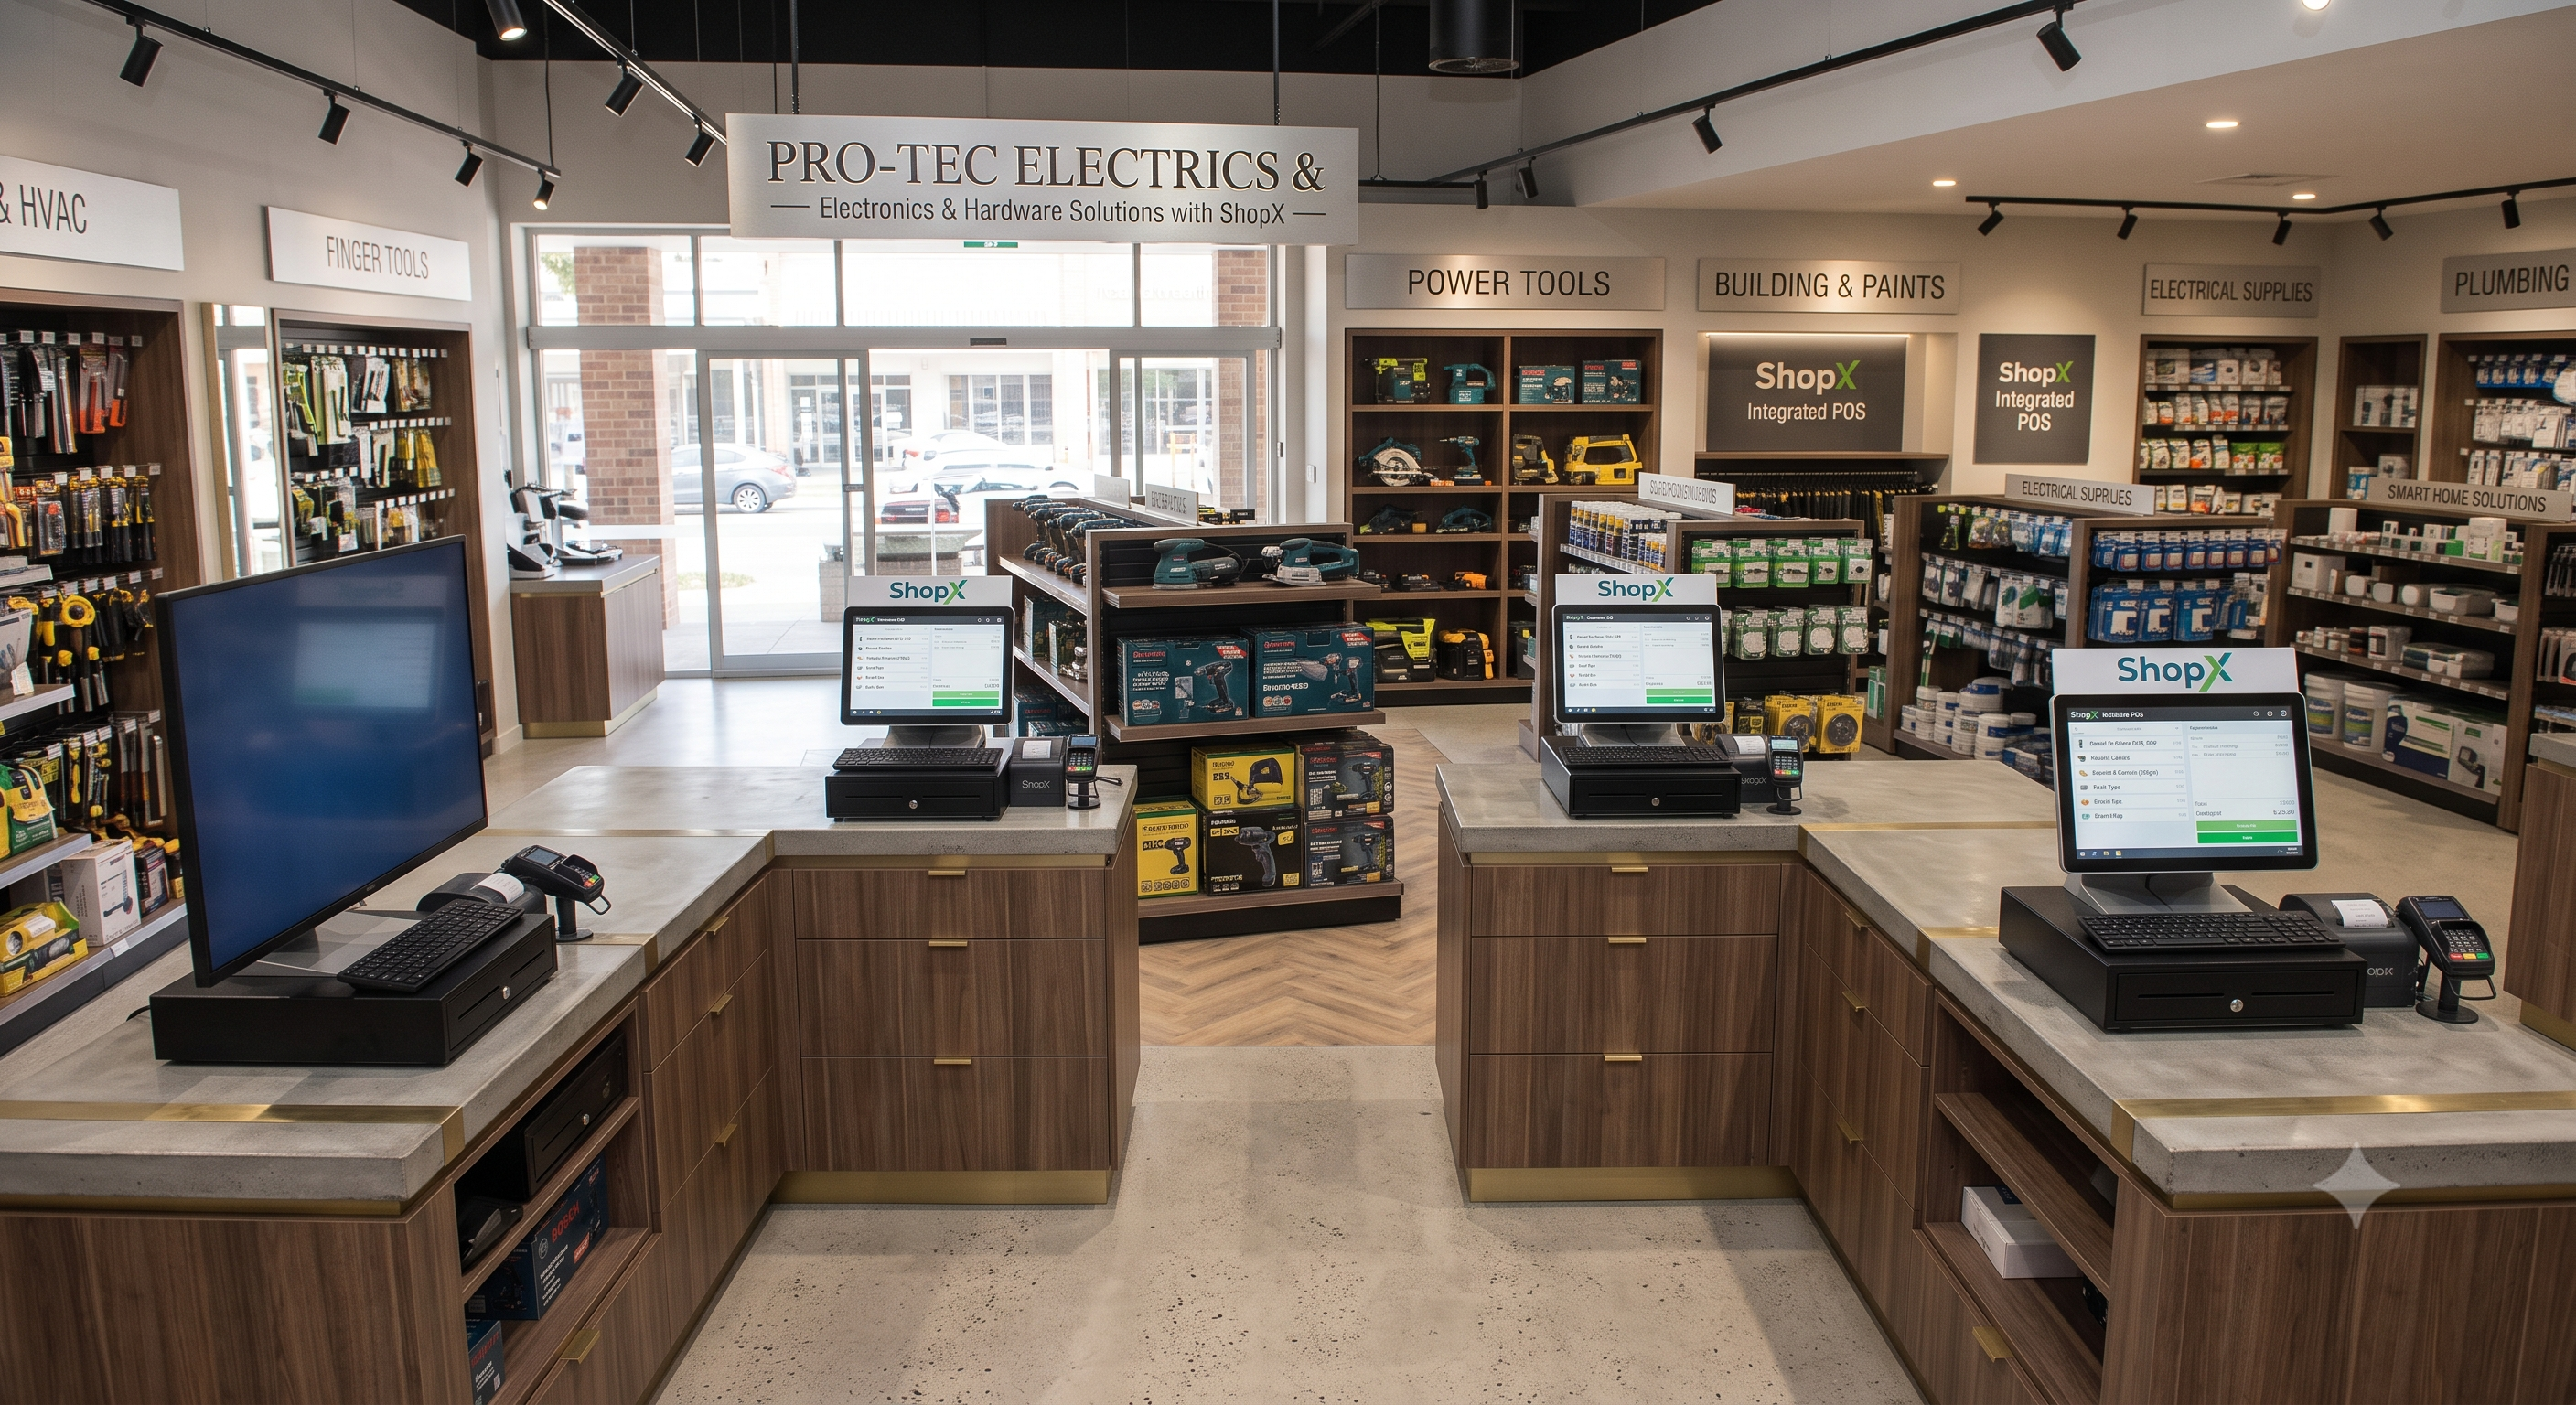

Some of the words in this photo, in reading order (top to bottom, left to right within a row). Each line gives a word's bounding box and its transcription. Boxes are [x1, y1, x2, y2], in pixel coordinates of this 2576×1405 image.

[767, 141, 998, 186] PRO-TEC
[1014, 145, 1280, 191] ELECTRICS
[1292, 152, 1326, 192] &
[20, 184, 87, 234] HVAC
[821, 196, 934, 220] Electronics
[941, 198, 958, 220] &
[965, 198, 1062, 221] Hardware
[1069, 199, 1164, 223] Solutions
[1172, 202, 1213, 223] with
[1220, 202, 1285, 228] ShopX
[327, 235, 382, 273] FINGER
[385, 245, 429, 279] TOOLS
[1409, 269, 1509, 295] POWER
[1519, 270, 1610, 296] TOOLS
[1715, 272, 1829, 298] BUILDING
[1838, 273, 1853, 298] &
[1862, 274, 1945, 300] PAINTS
[2151, 279, 2238, 301] ELECTRICAL
[2243, 281, 2313, 302] SUPPLIES
[2455, 264, 2570, 296] PLUMBING
[1755, 360, 1861, 395] ShopX
[1999, 361, 2074, 388] ShopX
[1747, 402, 1827, 424] Integrated
[1832, 402, 1866, 420] POS
[1995, 390, 2075, 412] Integrated
[2017, 413, 2051, 431] POS
[2022, 480, 2078, 500] ELECTRICAL
[2388, 484, 2430, 502] SMART
[2432, 488, 2469, 506] HOME
[2472, 490, 2547, 513] SOLUTIONS
[889, 579, 968, 605] ShopX
[1597, 577, 1674, 602] ShopX
[2117, 652, 2234, 692] ShopX
